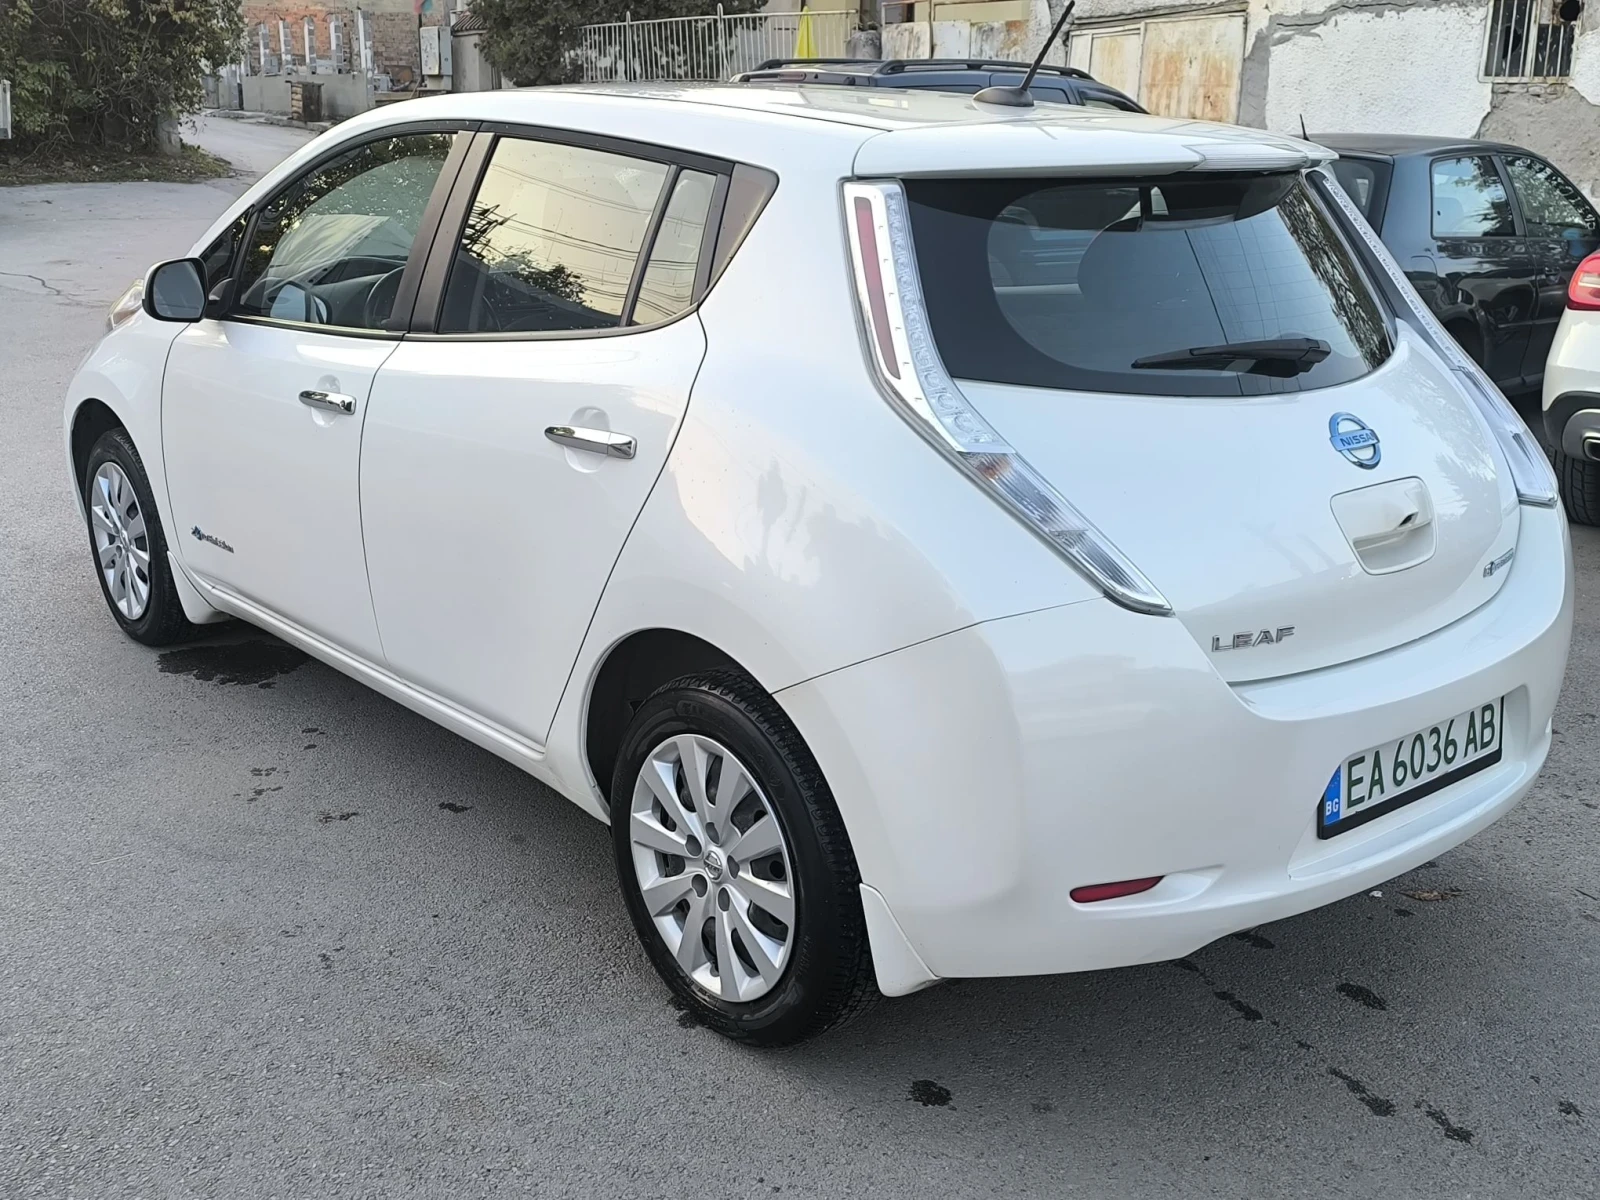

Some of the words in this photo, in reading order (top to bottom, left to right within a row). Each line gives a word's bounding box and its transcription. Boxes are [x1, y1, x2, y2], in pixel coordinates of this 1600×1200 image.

[1211, 626, 1295, 652] LEAF
[1347, 750, 1385, 809] EA
[1393, 719, 1458, 787] 6036
[1463, 703, 1496, 758] AB
[1325, 798, 1340, 816] BG
